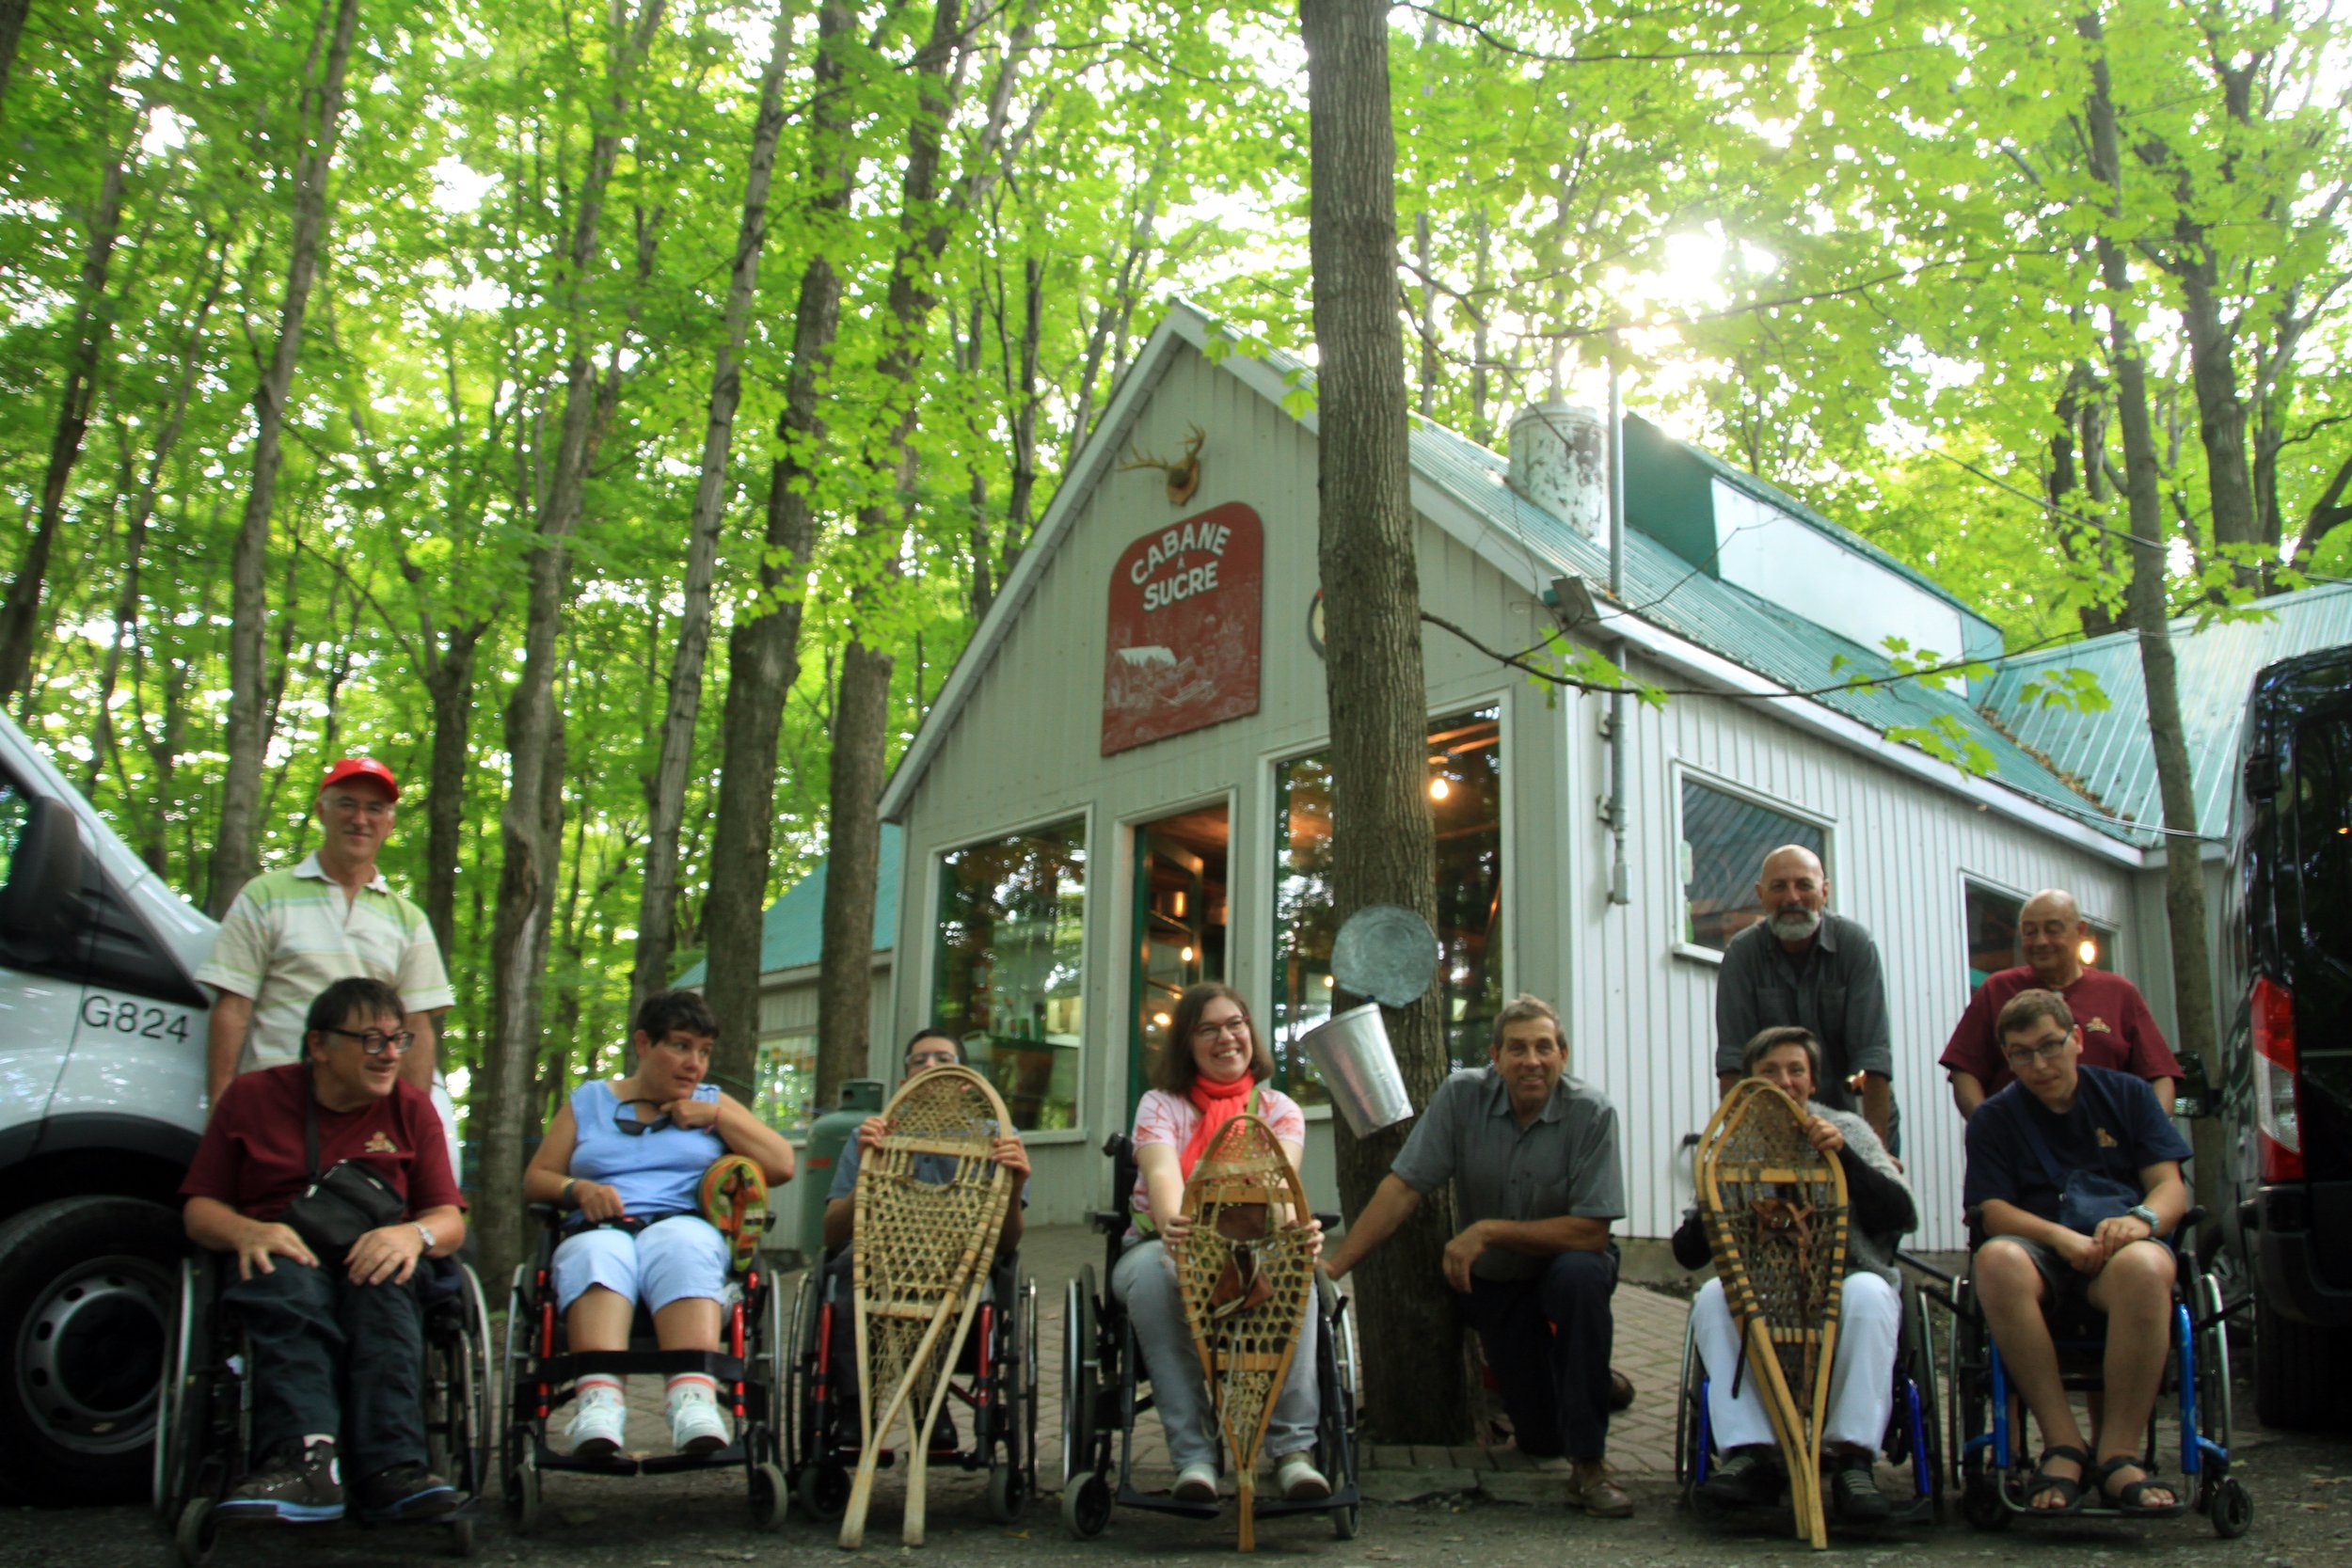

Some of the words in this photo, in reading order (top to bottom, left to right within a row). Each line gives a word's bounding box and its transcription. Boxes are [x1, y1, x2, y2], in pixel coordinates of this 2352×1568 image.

[1131, 522, 1232, 585] CABANE
[1143, 562, 1218, 611] SUCRE
[82, 995, 190, 1043] G824
